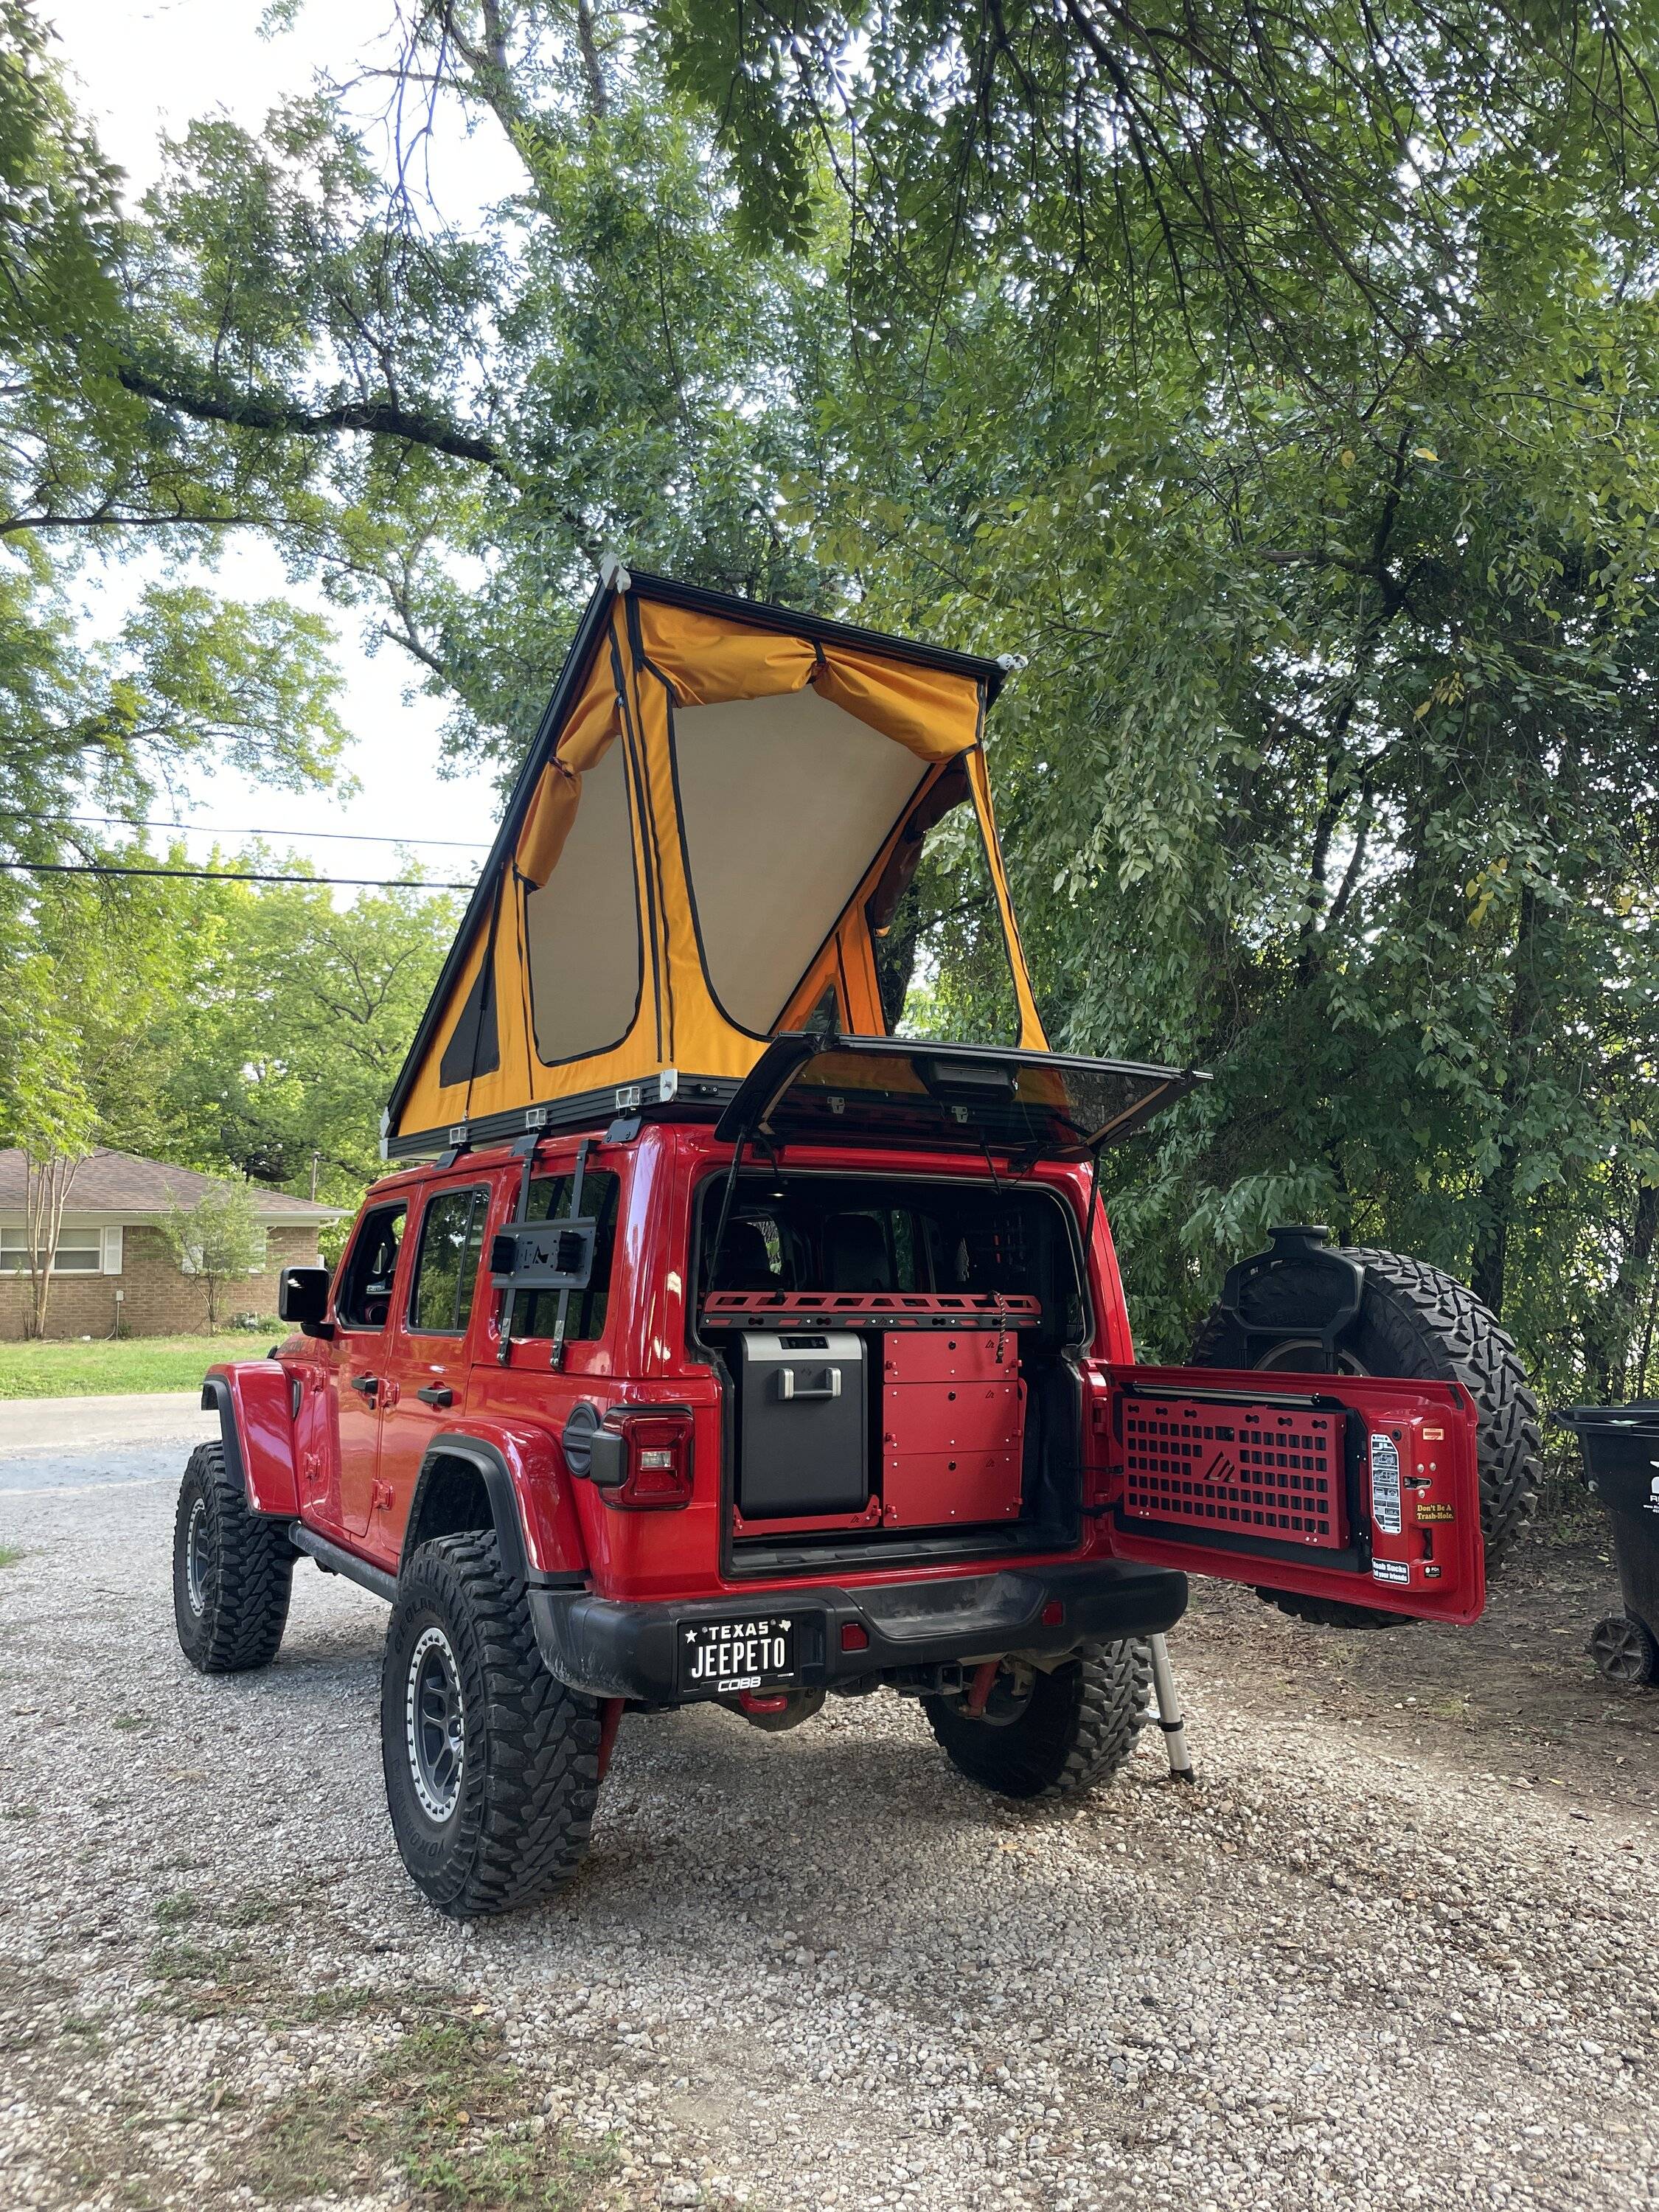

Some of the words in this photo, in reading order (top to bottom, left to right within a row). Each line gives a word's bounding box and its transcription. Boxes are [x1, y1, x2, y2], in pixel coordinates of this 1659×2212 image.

[1386, 1564, 1407, 1573] Sucks
[709, 1621, 768, 1641] TEXAS
[691, 1638, 785, 1678] JEEPETO
[717, 1676, 762, 1692] COBB
